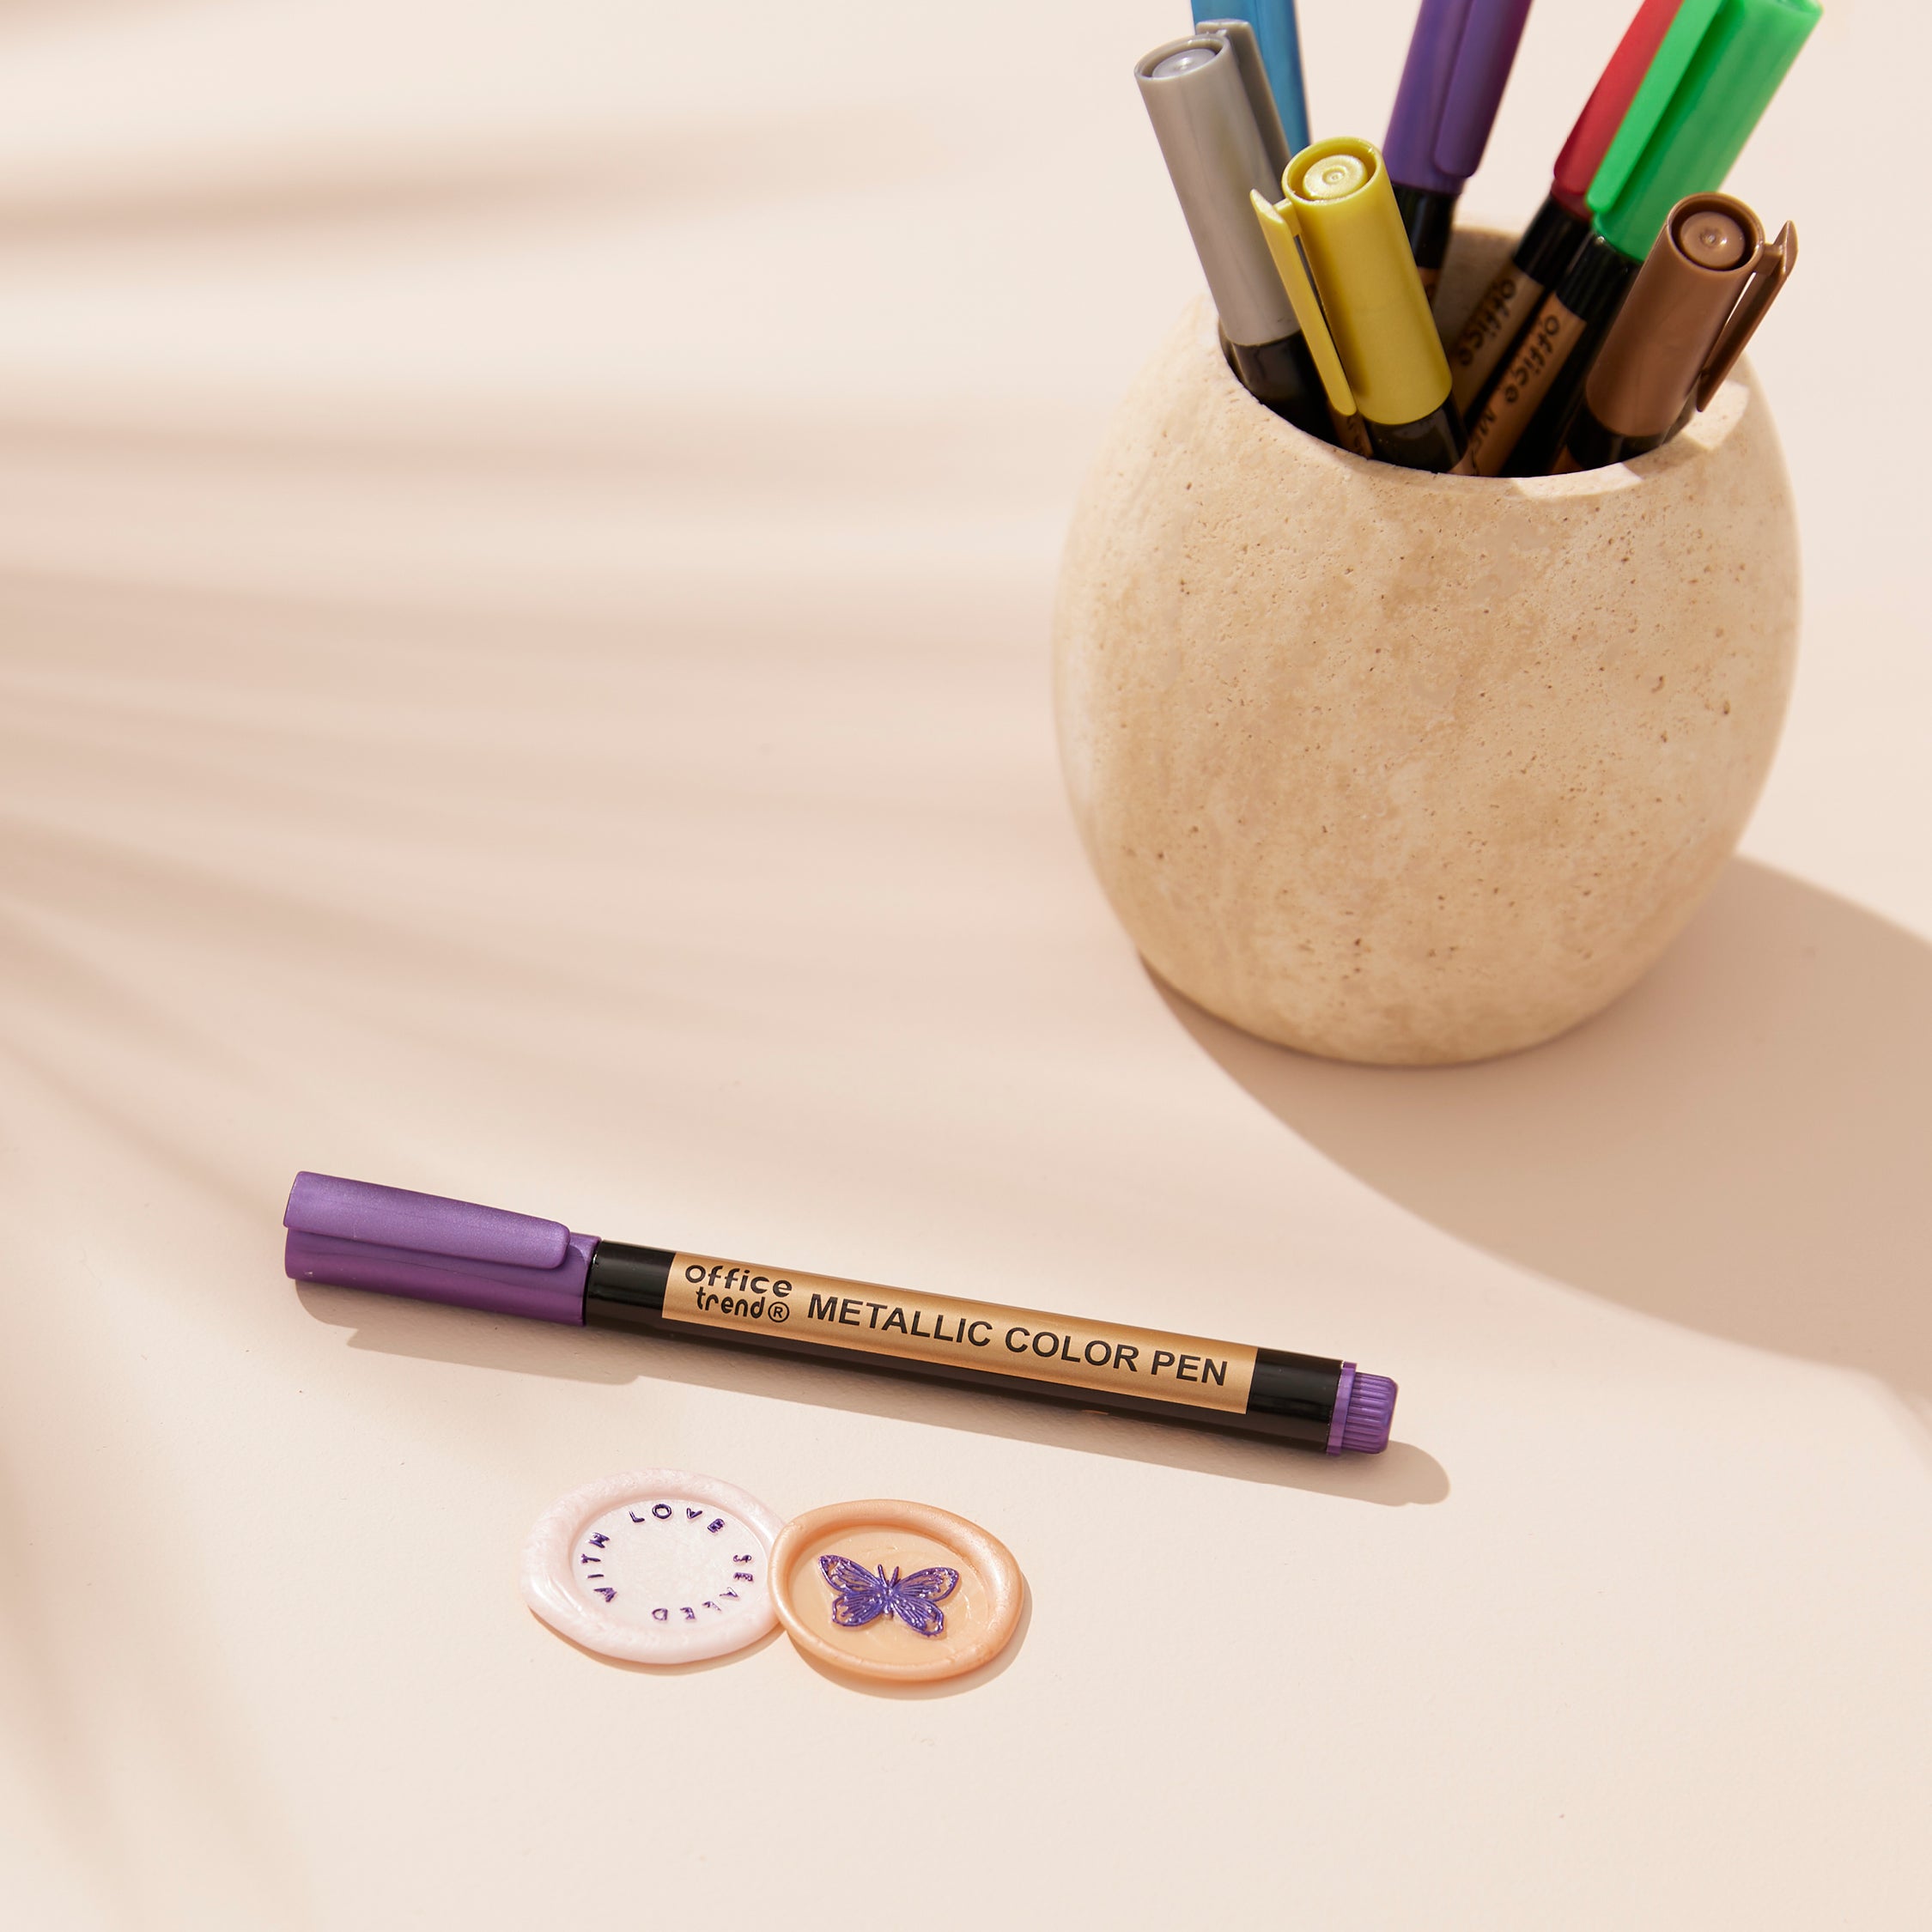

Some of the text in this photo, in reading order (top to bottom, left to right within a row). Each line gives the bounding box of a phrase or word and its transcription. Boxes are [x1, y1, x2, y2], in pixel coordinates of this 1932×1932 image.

[1504, 314, 1559, 404] office
[684, 1264, 793, 1298] office
[807, 1293, 1228, 1387] METALLIC COLOR PEN
[580, 1503, 754, 1621] SEALED WITH LOVE
